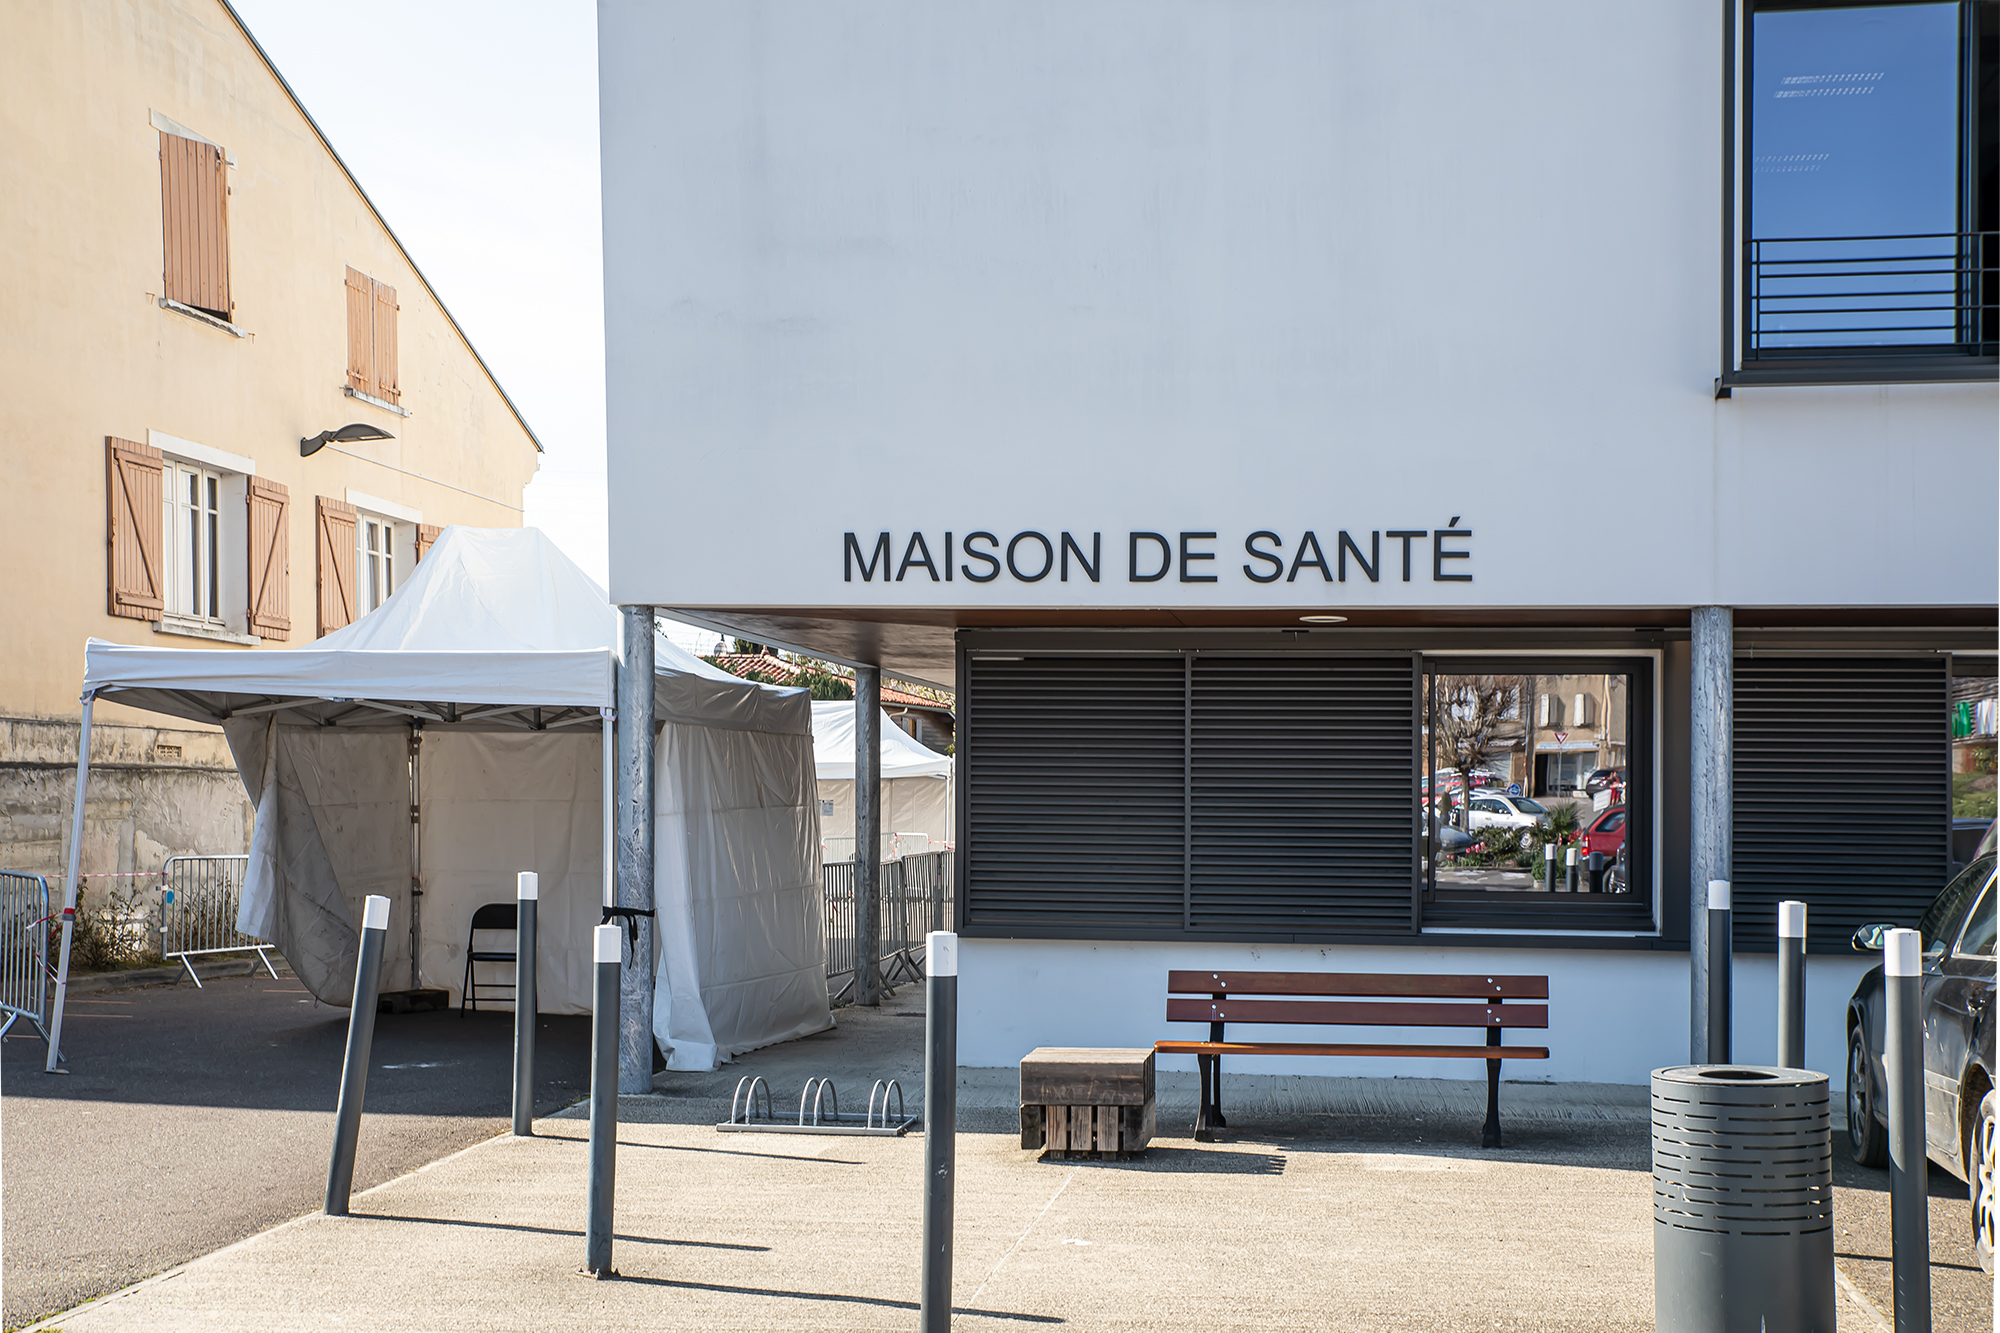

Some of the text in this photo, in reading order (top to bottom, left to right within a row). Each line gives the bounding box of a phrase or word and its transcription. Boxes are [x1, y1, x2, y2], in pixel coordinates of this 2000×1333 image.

[844, 515, 1473, 584] MAISON DE SANTÉ
